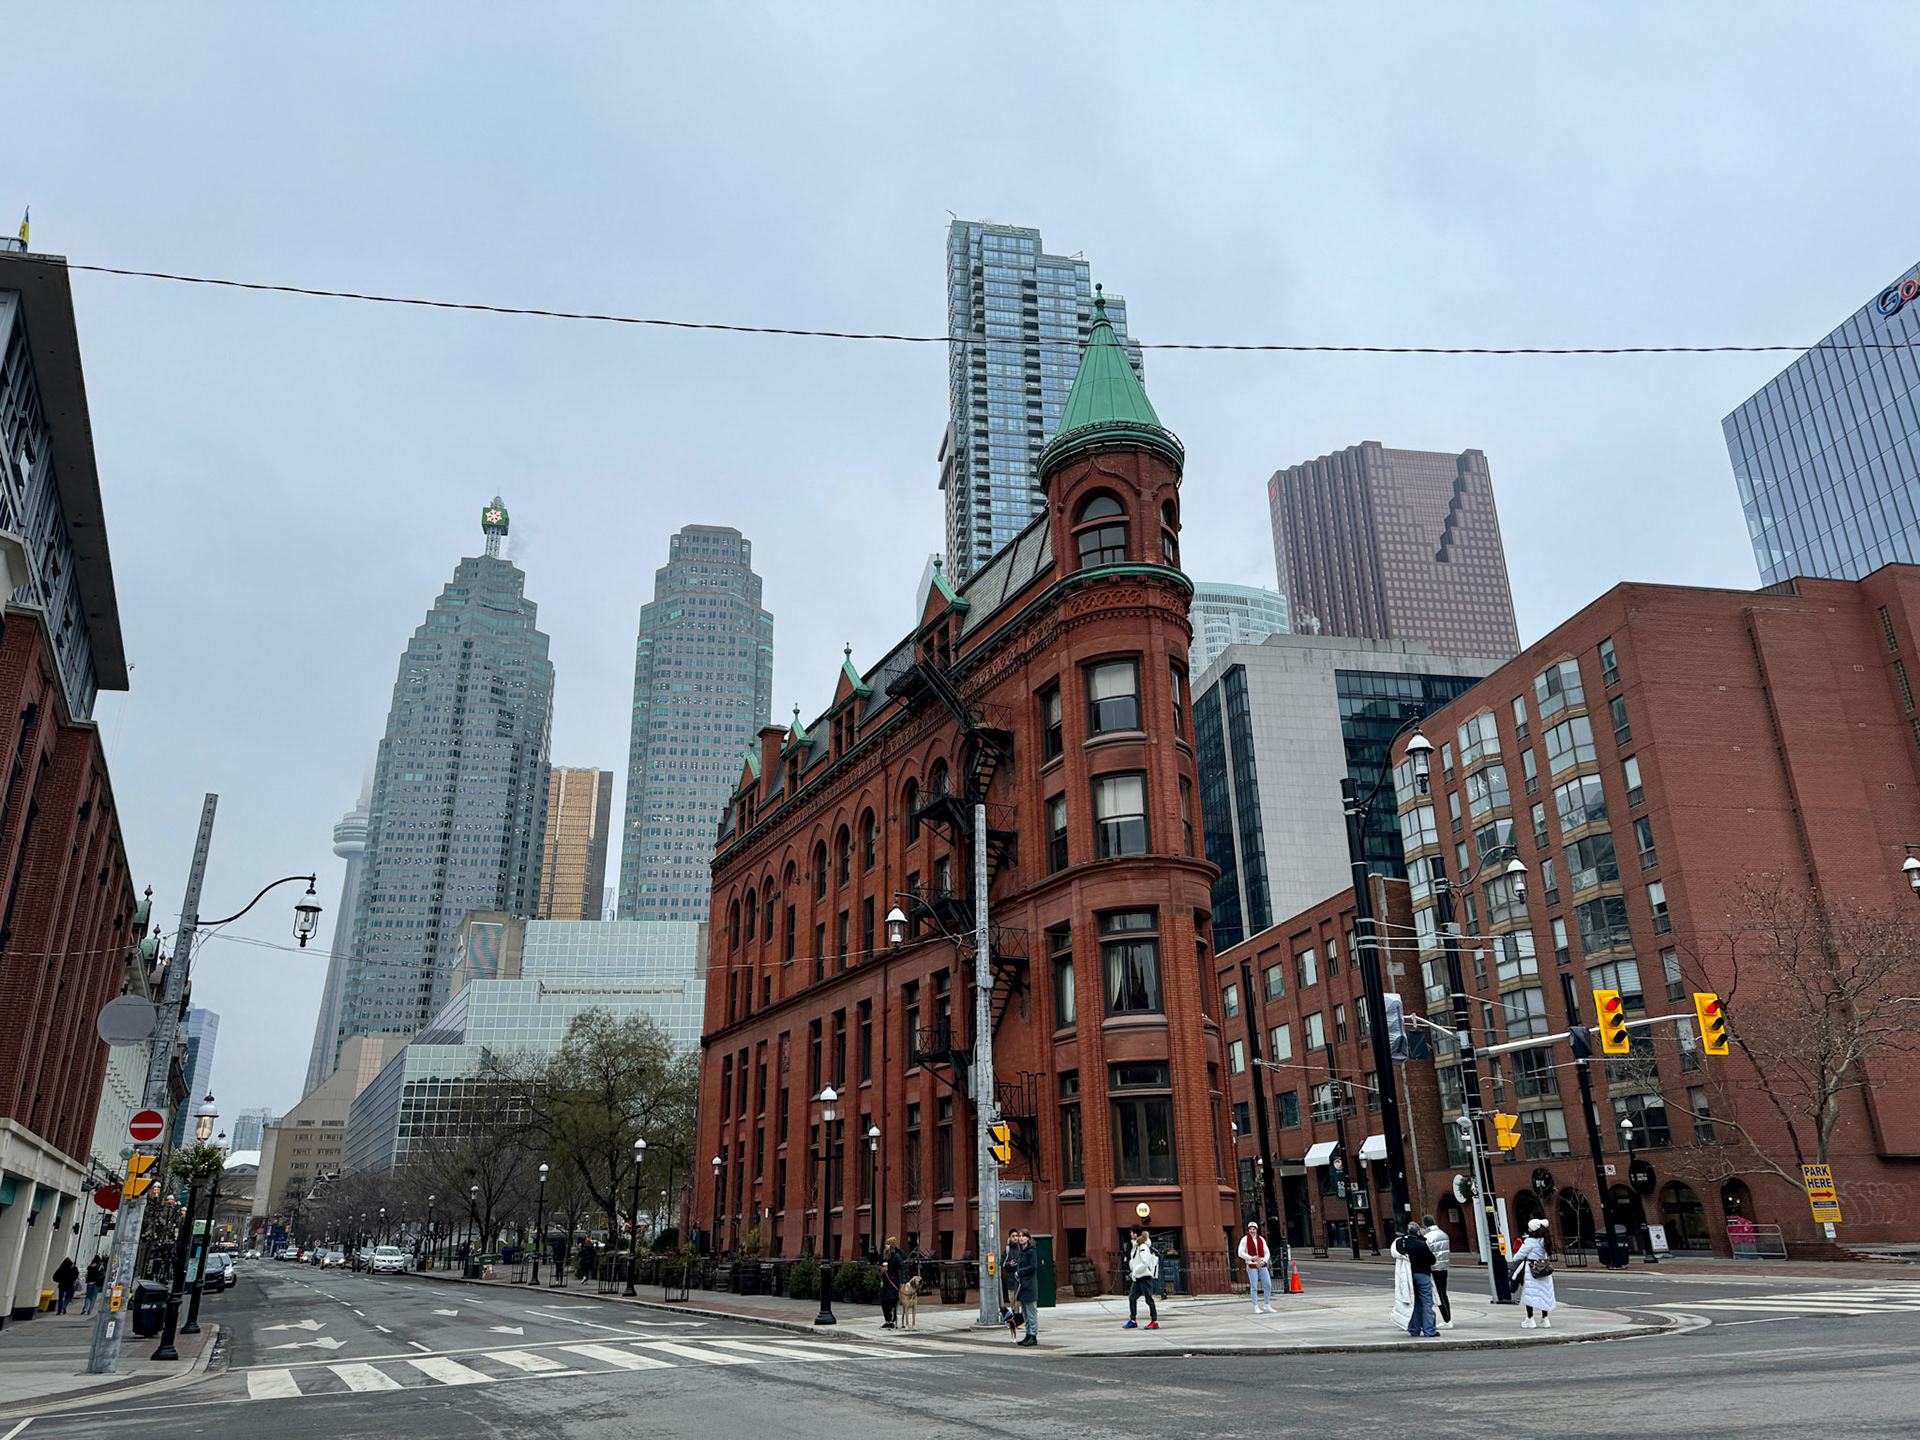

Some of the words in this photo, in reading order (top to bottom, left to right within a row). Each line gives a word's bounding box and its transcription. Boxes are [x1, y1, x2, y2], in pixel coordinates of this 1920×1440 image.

[1876, 270, 1920, 315] Go
[1804, 1166, 1829, 1176] PARK
[1807, 1178, 1832, 1188] HERE
